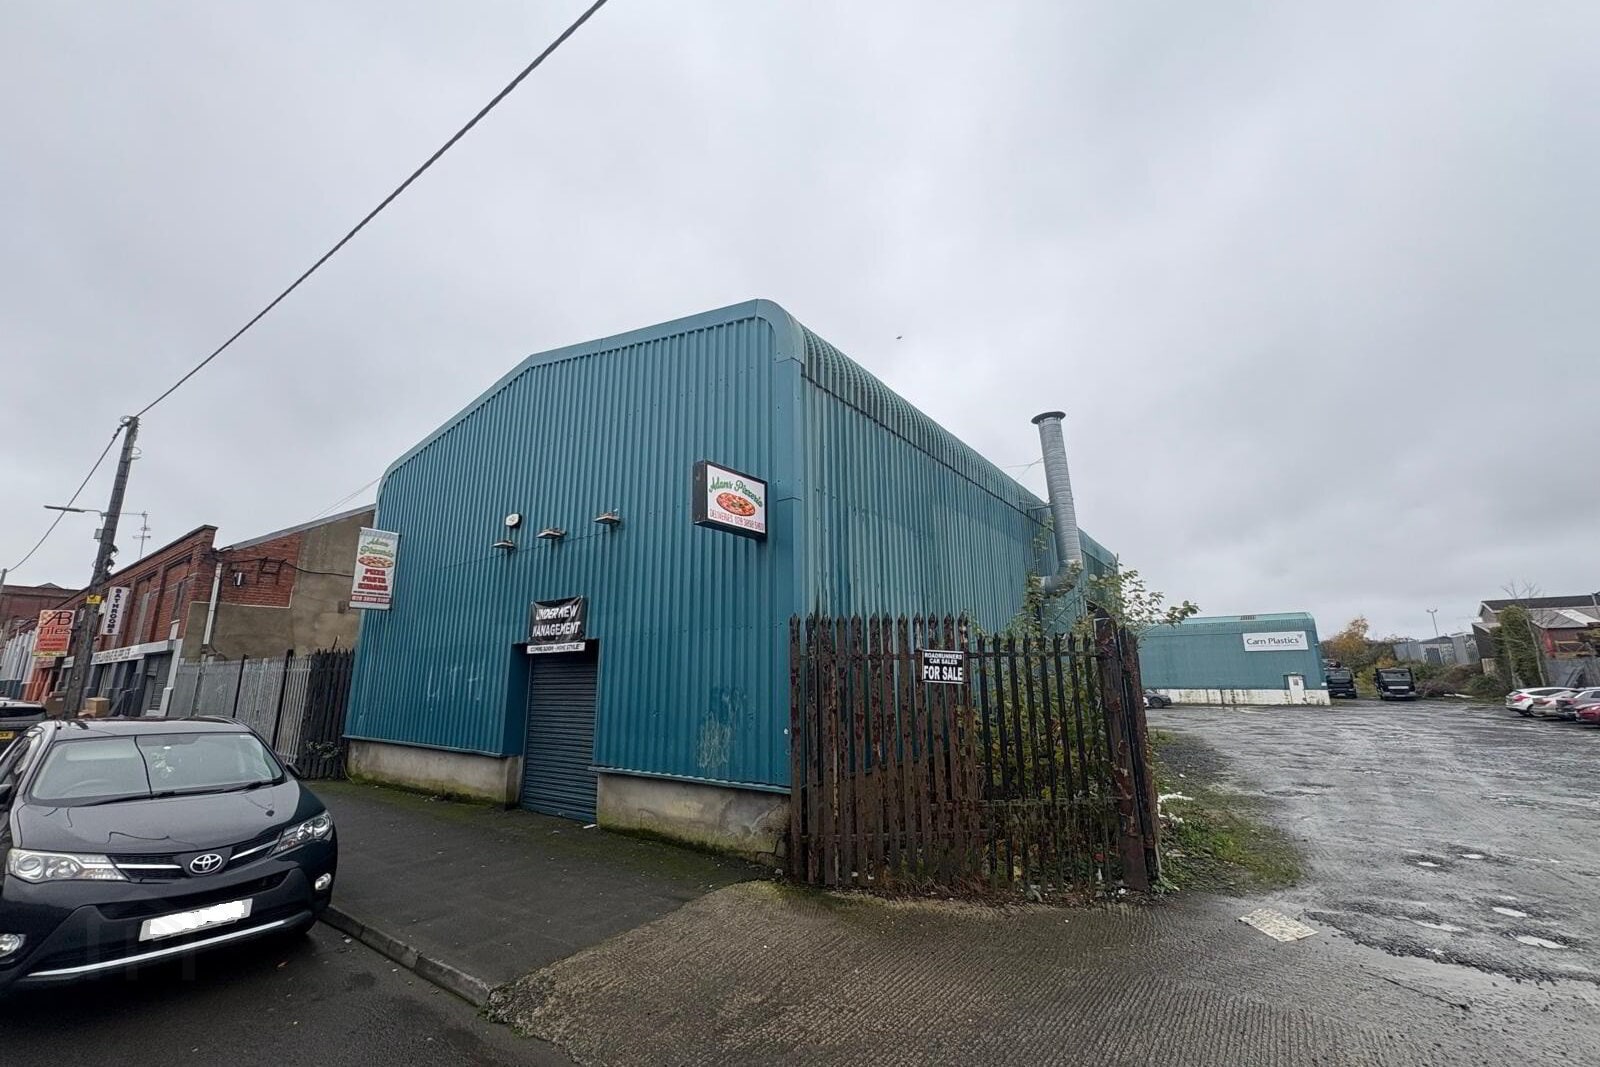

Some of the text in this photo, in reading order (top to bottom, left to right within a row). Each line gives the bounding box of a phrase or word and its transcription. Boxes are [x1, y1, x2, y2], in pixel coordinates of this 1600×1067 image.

[734, 479, 763, 508] Pizzeria
[362, 575, 386, 584] PASTA
[44, 611, 73, 625] AB
[107, 588, 122, 633] BATHROOMS
[536, 604, 578, 620] UNDER NEW
[39, 626, 72, 635] Tiles
[532, 621, 581, 637] MANAGEMENT
[1268, 636, 1300, 644] Plastics
[923, 665, 963, 681] FOR SALE
